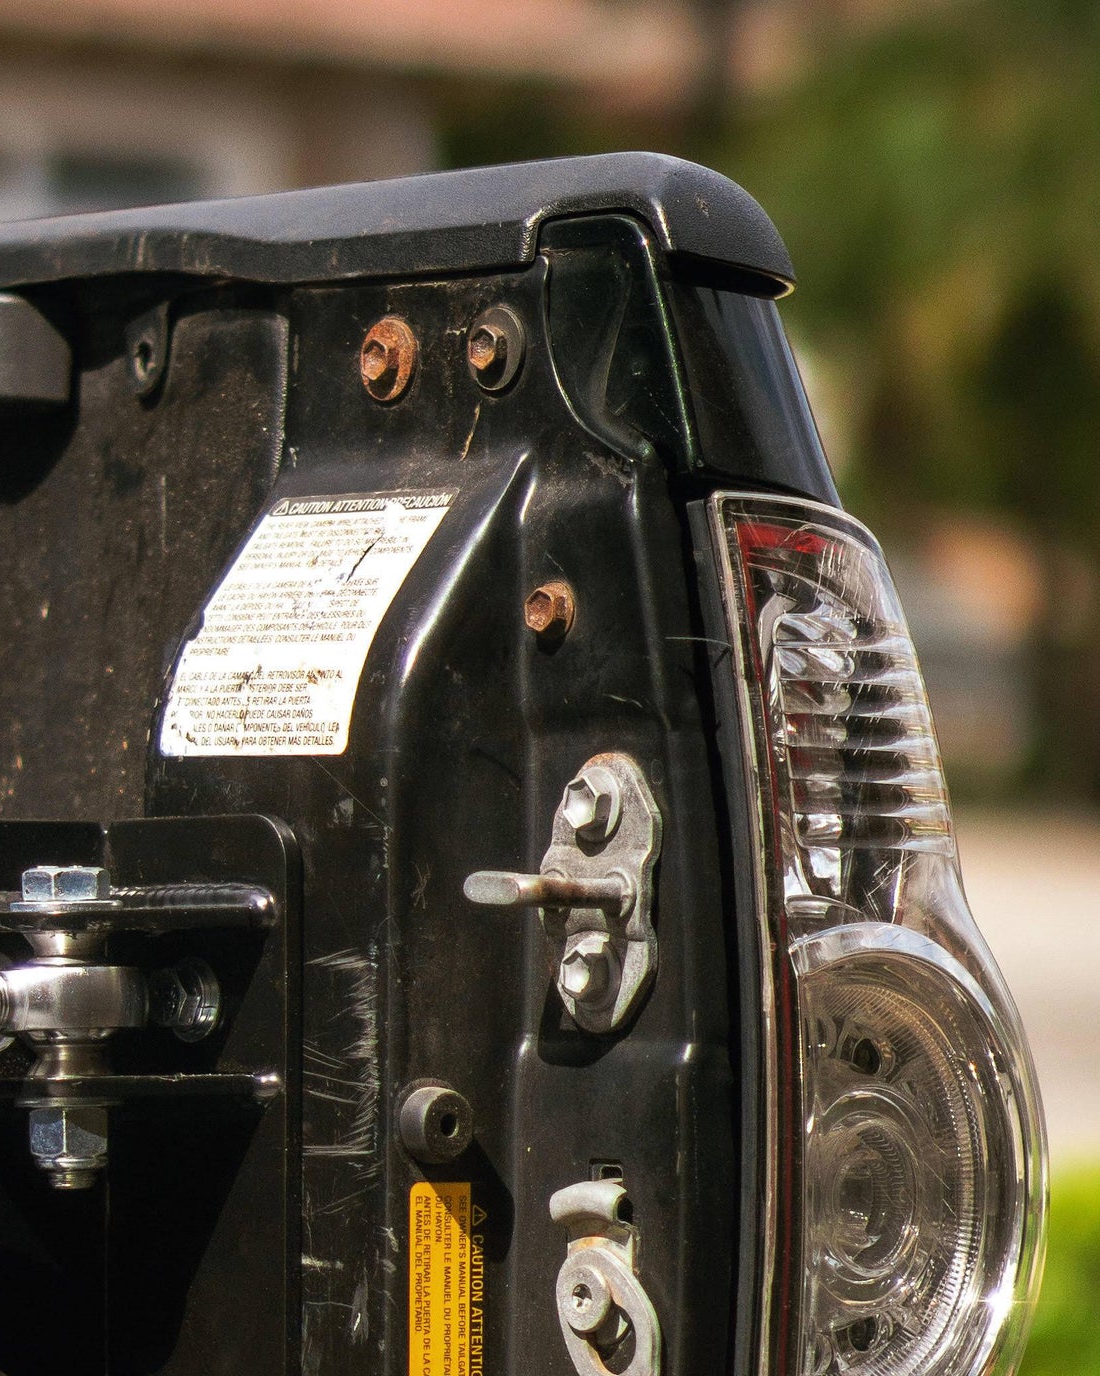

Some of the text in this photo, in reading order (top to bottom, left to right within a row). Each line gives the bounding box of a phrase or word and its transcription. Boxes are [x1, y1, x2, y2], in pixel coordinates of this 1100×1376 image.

[289, 501, 333, 514] CAUTION
[331, 498, 388, 512] ATTENTION
[268, 669, 305, 680] RETROVISOR
[278, 682, 294, 692] DEBE
[288, 695, 311, 705] PUERTA
[266, 708, 291, 719] CAUSAR
[292, 706, 314, 718] DAÑOS
[236, 722, 281, 733] CMPONENTES
[214, 735, 239, 746] USUAR
[258, 735, 287, 746] OBTENER
[415, 1196, 422, 1208] EL
[434, 1196, 442, 1208] DU
[458, 1196, 467, 1211] SEE
[423, 1196, 431, 1226] ANTES
[444, 1195, 452, 1250] CONSULTER
[423, 1228, 431, 1240] DE
[458, 1215, 467, 1258] OWNER'S
[423, 1244, 431, 1282] RETIRAR
[444, 1252, 451, 1262] LE
[471, 1234, 484, 1301] CAUTION
[443, 1266, 451, 1304] MANUEL
[458, 1261, 466, 1300] MANUAL
[423, 1285, 431, 1298] LA
[423, 1300, 431, 1335] PUERTA
[443, 1308, 451, 1321] DU
[458, 1303, 466, 1339] BEFORE
[423, 1338, 430, 1350] DE
[423, 1352, 430, 1364] LA
